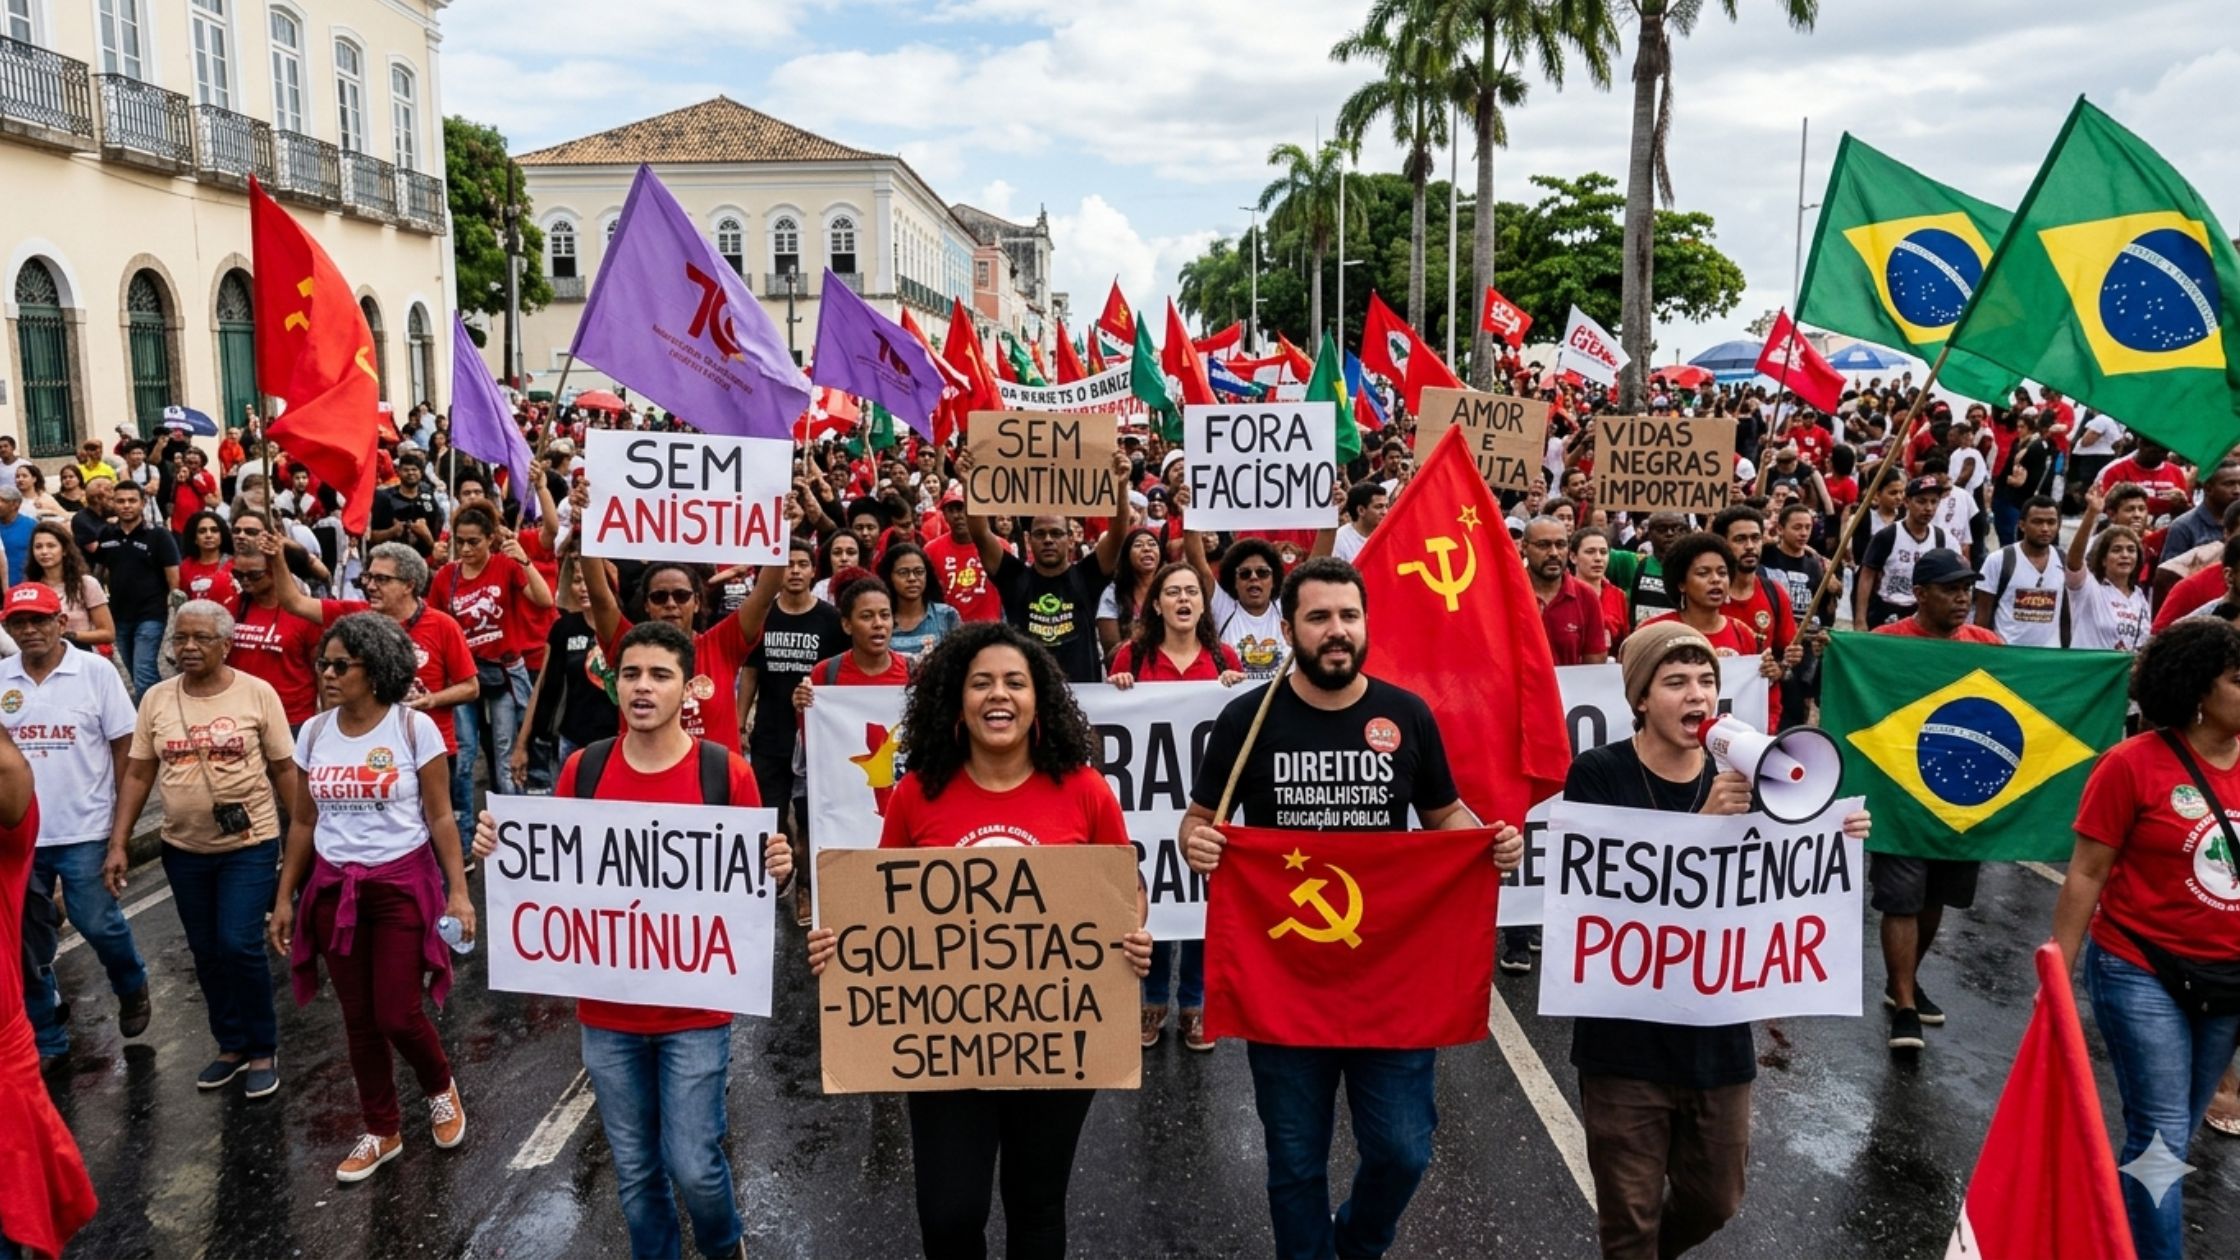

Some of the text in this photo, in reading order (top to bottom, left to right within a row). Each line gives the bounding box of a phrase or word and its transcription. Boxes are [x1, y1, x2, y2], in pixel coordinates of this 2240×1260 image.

[1206, 413, 1313, 454] FORA
[1450, 397, 1524, 433] AMOR
[1602, 418, 1693, 448] VIDAS
[998, 419, 1081, 460] SEM
[1482, 433, 1496, 451] E
[625, 439, 742, 493] SEM
[1191, 458, 1336, 509] FACISMO
[1477, 455, 1529, 487] UTA
[1610, 450, 1721, 477] NEGRAS
[1599, 474, 1729, 508] IMPORTAM
[596, 493, 783, 556] ANISTIA!
[1273, 750, 1394, 783] DIREITOS
[498, 820, 769, 898] SEM ANISTIA!
[1560, 827, 1851, 909] RESISTÊNCIA
[876, 858, 1047, 914] FORA
[512, 899, 737, 975] CONTÍNUA
[1574, 915, 1828, 995] POPULAR
